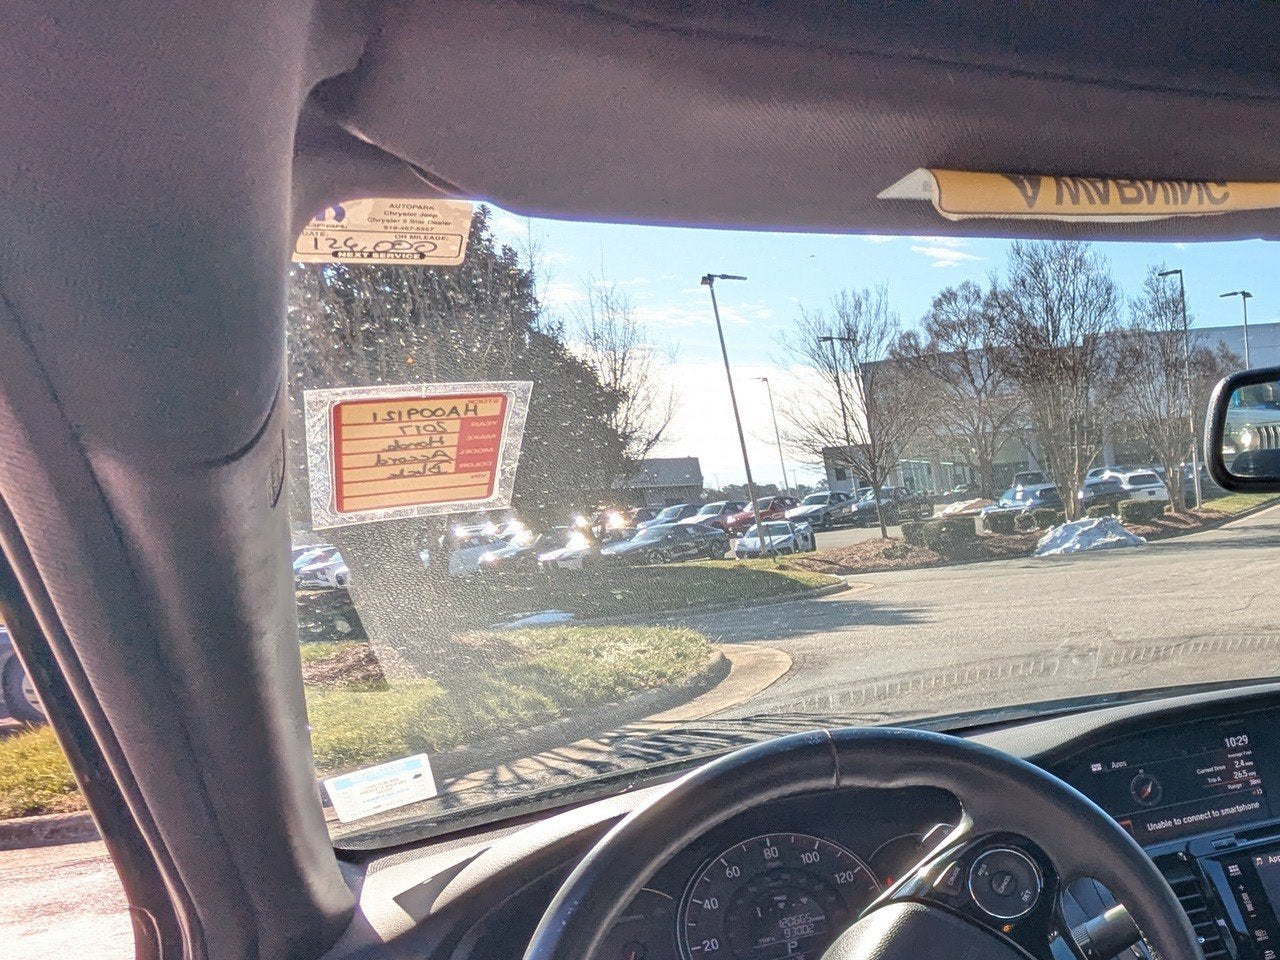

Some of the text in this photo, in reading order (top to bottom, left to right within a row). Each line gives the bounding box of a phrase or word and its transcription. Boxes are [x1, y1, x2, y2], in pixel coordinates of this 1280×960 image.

[1224, 735, 1249, 748] 10:29
[1111, 760, 1127, 769] Apps
[1147, 801, 1260, 831] Unable to connect to smartphone
[764, 847, 778, 860] 80
[801, 852, 820, 865] 100
[726, 865, 740, 879] 60
[835, 871, 854, 885] 120
[703, 898, 719, 910] 40
[703, 938, 719, 952] 20
[787, 941, 798, 954] P
